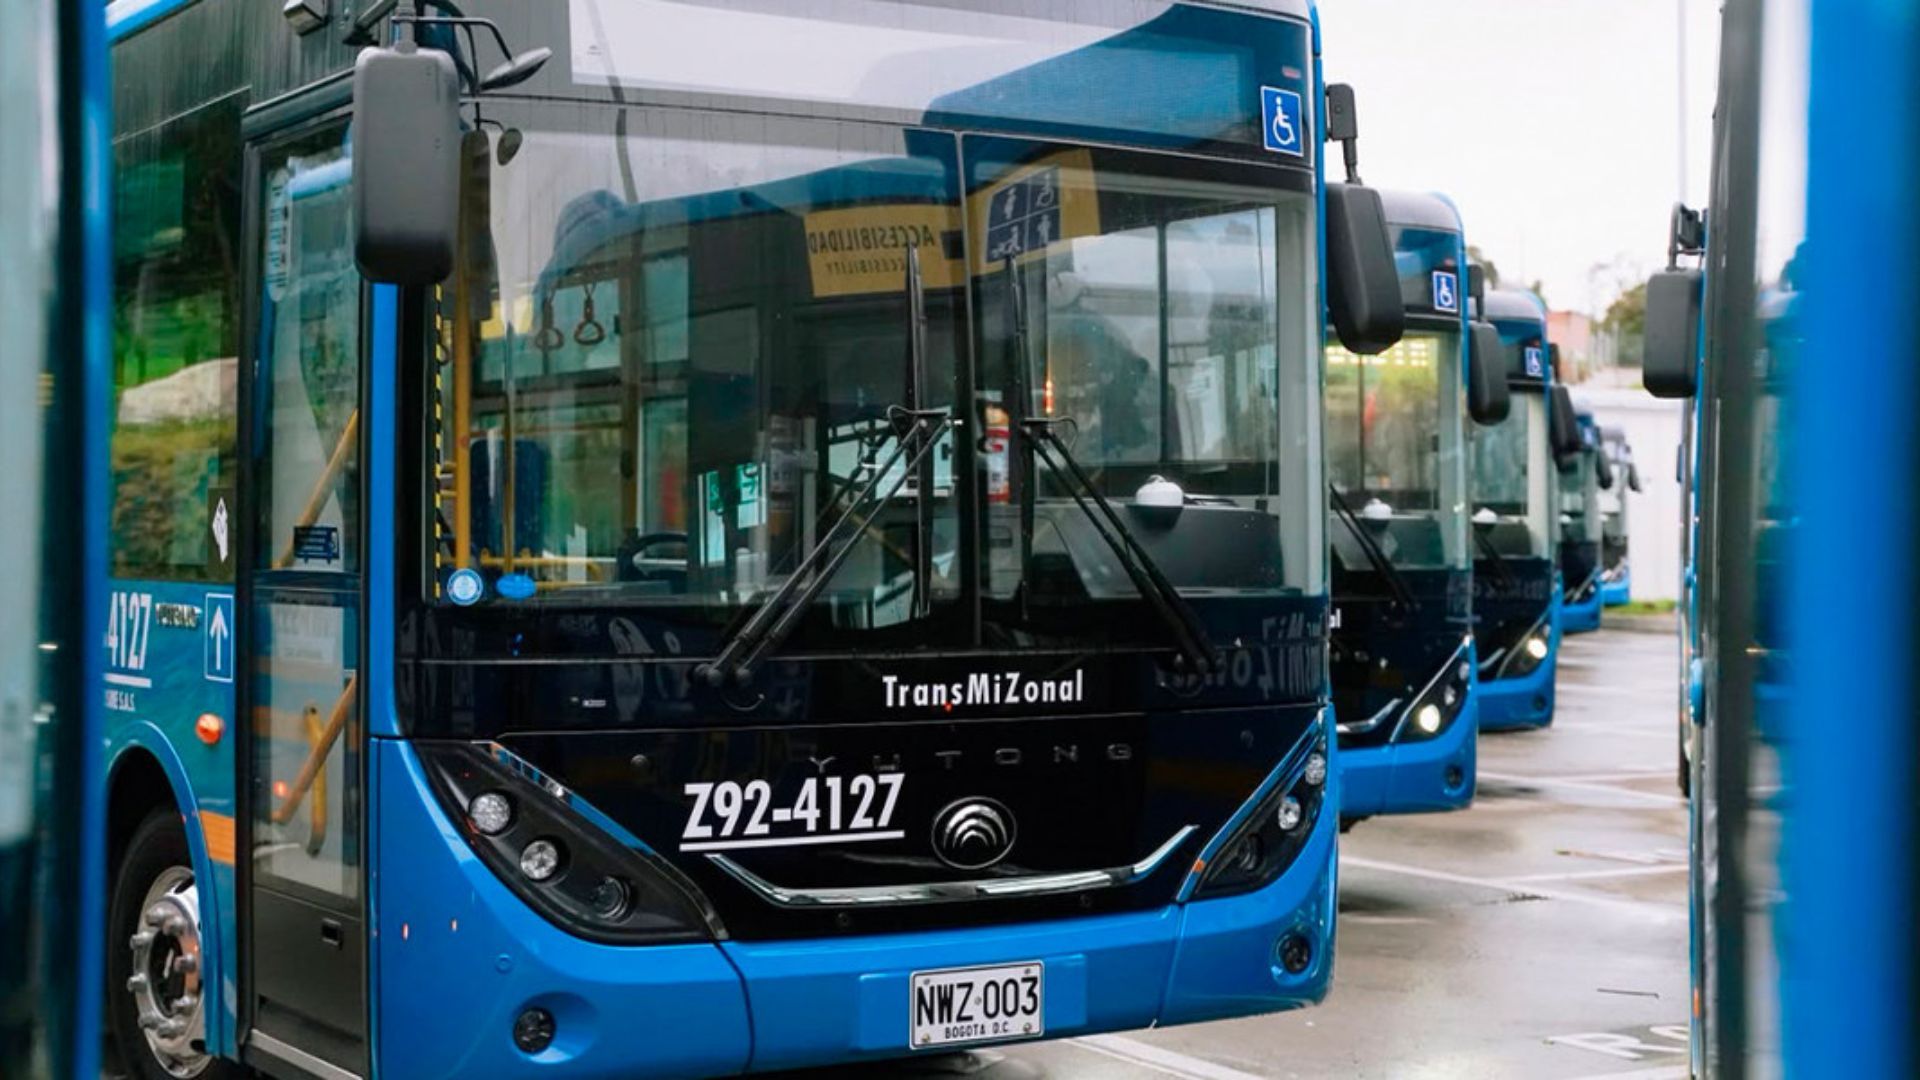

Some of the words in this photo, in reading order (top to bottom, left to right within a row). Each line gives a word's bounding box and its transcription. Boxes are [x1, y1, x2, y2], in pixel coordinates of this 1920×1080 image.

[882, 669, 1083, 707] TransMiZonal
[808, 744, 1133, 773] YUTONG
[682, 773, 905, 838] Z92-4127
[917, 982, 974, 1026] NWZ
[983, 976, 1038, 1018] 003
[945, 1023, 986, 1039] BOGOTA
